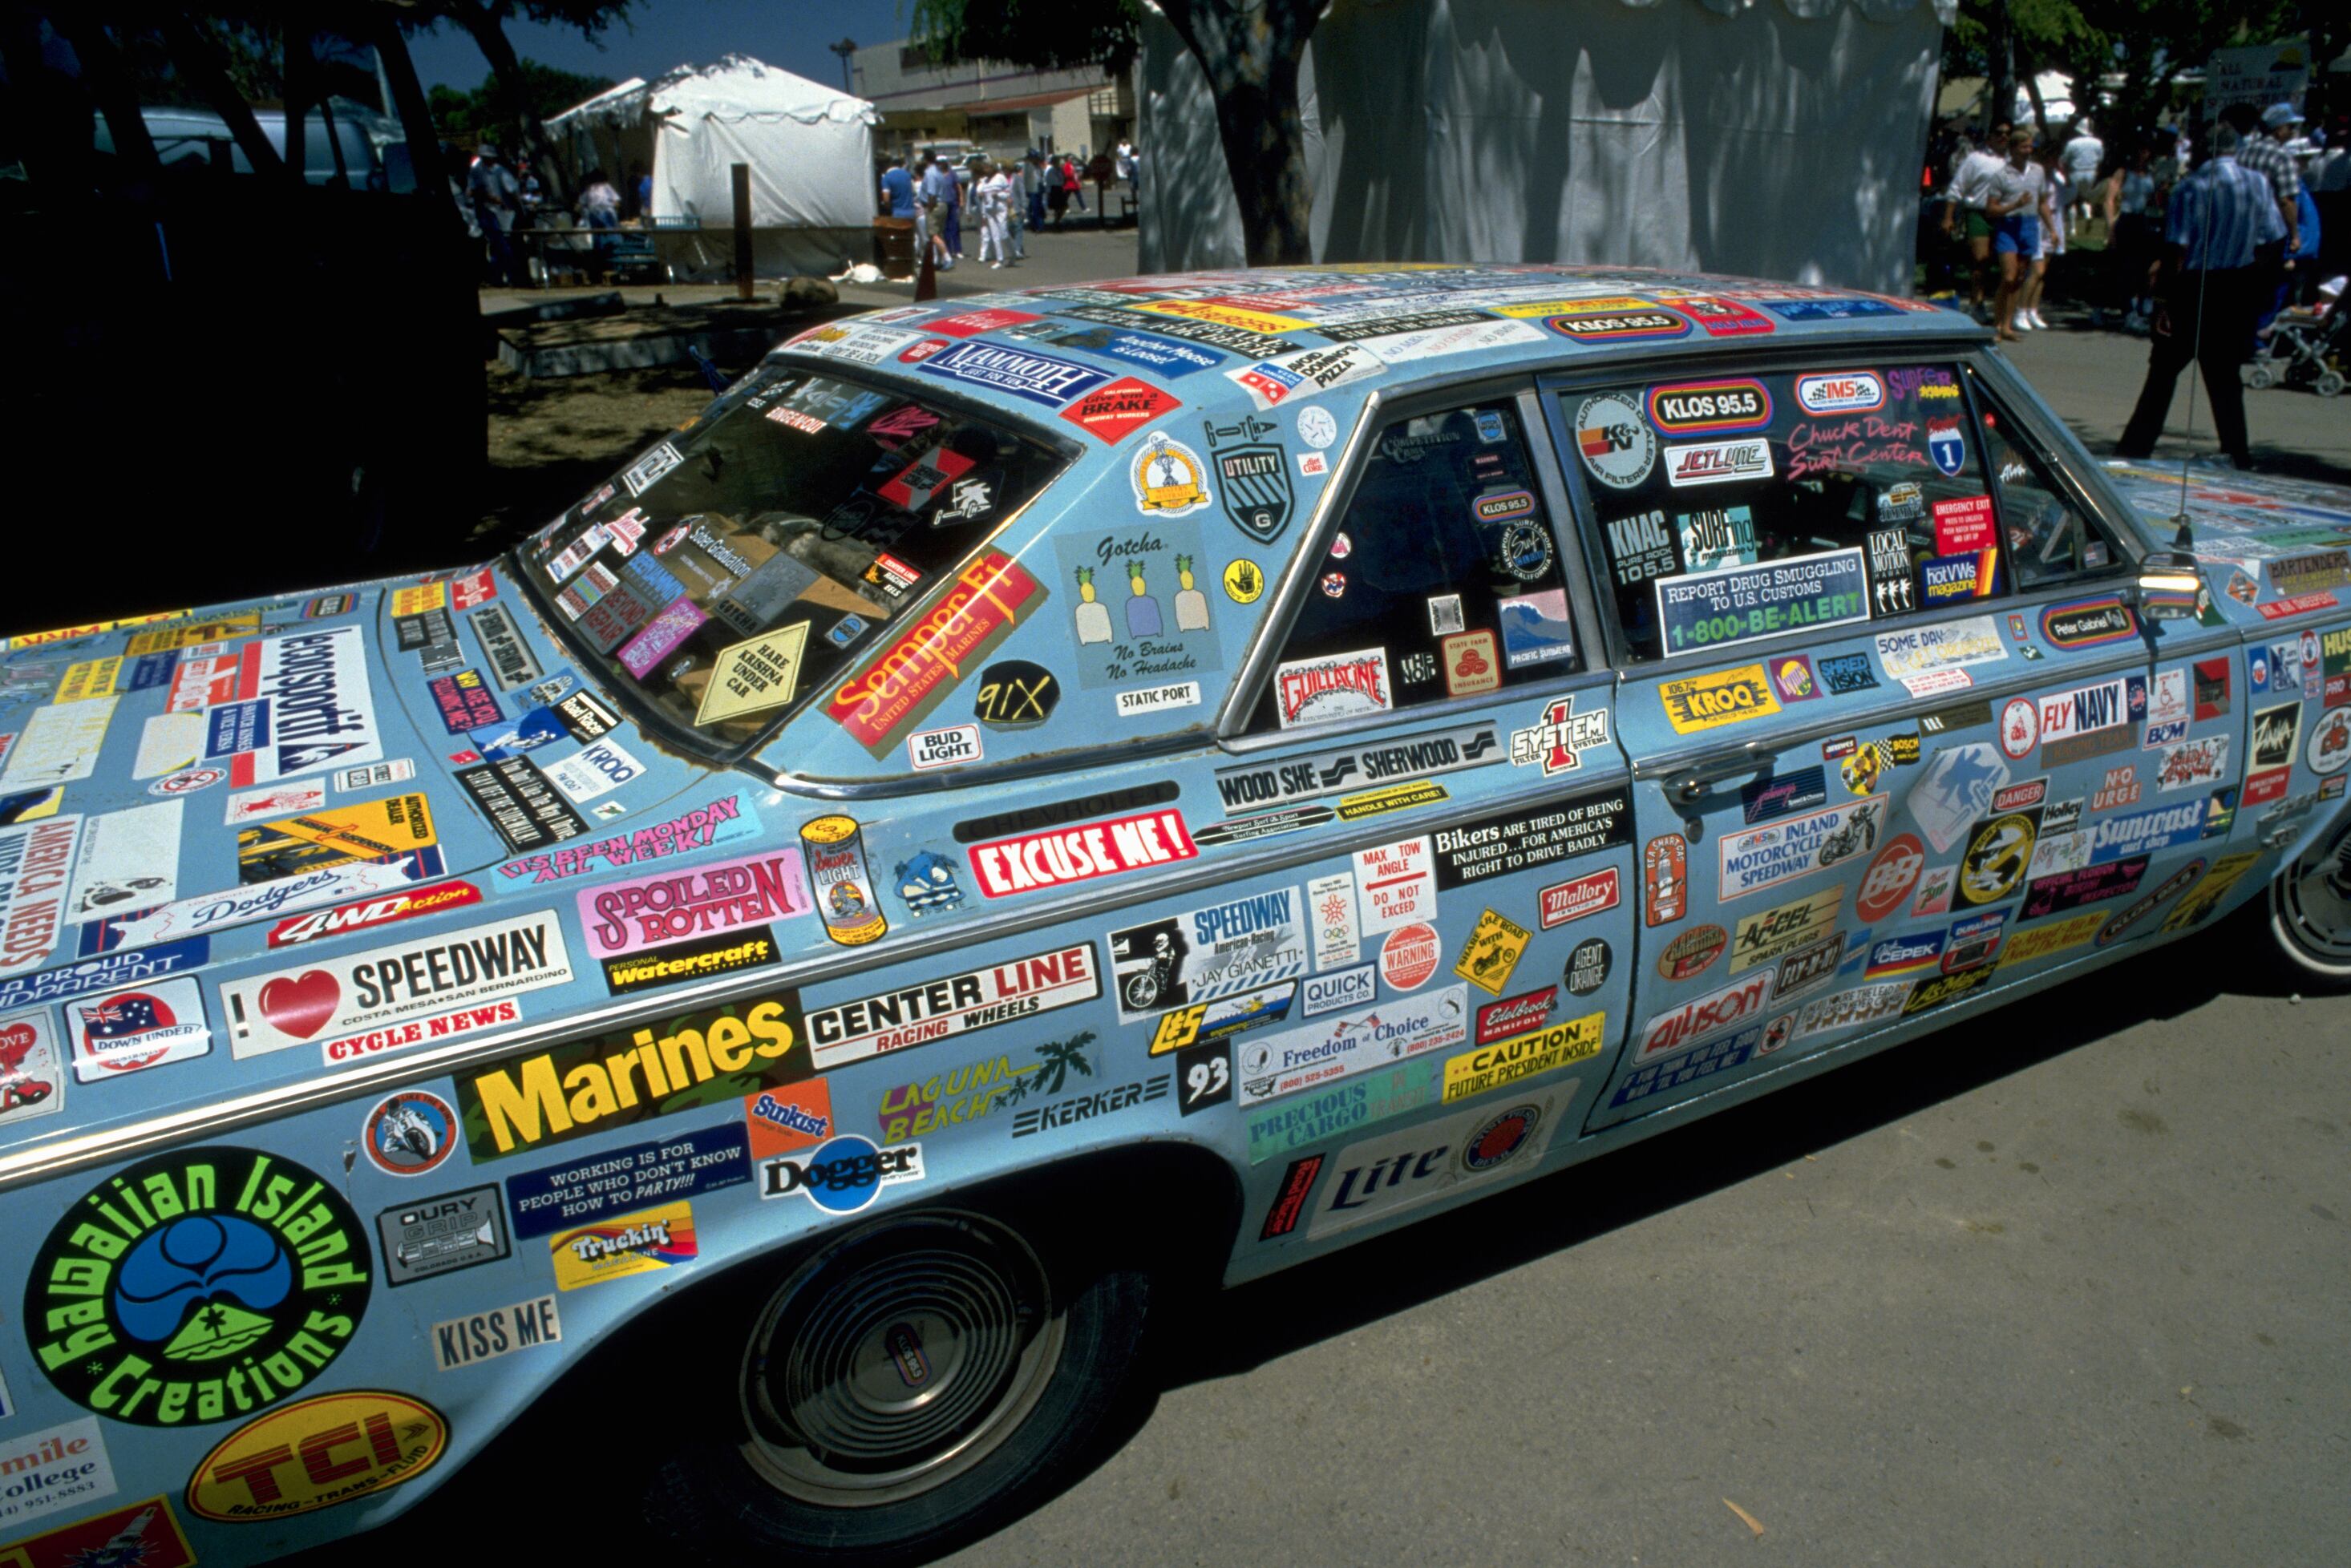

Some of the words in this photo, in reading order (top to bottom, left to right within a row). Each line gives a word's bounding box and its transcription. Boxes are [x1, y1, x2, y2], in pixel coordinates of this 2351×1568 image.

[939, 345, 1095, 396] MAMMOTH
[1287, 351, 1324, 373] AVOID
[1301, 344, 1360, 377] DOMINO'S
[1314, 360, 1355, 388] PIZZA
[964, 367, 985, 375] JUST
[987, 372, 1003, 382] FOR
[1004, 377, 1022, 386] FUN
[1826, 381, 1855, 399] IMS
[1082, 398, 1157, 416] BRAKE
[1084, 414, 1115, 423] HIGHWAY
[1663, 397, 1716, 419] KLOS
[1718, 393, 1757, 413] 95.5
[1788, 422, 1860, 452] Chuck
[1863, 416, 1919, 441] Dent
[1224, 456, 1277, 478] UTILITY
[1941, 443, 1955, 467] 1
[1483, 502, 1507, 515] KLOS
[1508, 499, 1528, 510] 95.5
[1936, 503, 1974, 515] EMERGENCY
[1976, 499, 1990, 510] EXIT
[1608, 510, 1669, 559] KNAC
[1870, 531, 1906, 556] LOCAL
[1617, 555, 1645, 568] PURE
[1646, 546, 1673, 559] ROCK
[1702, 548, 1746, 560] magazine
[1873, 551, 1910, 572] MOTION
[2269, 552, 2349, 576] BARTENDERS
[1617, 556, 1676, 584] 105.5
[1667, 581, 1725, 604] REPORT
[1730, 572, 1771, 593] DRUG
[1774, 560, 1856, 584] SMUGGLING
[1710, 597, 1730, 611] TO
[1735, 592, 1758, 607] U.S.
[1761, 581, 1822, 602] CUSTOMS
[1928, 579, 1977, 598] magazine
[1672, 592, 1861, 647] 1-800-BE-ALERT
[2054, 621, 2076, 636] Peter
[2077, 616, 2107, 631] Gabriel
[738, 649, 783, 688] KRISHNA
[758, 644, 790, 669] HARE
[455, 669, 481, 688] WHY
[726, 678, 751, 699] CAR
[731, 663, 768, 694] UNDER
[1454, 677, 1494, 689] INSURANCE
[463, 688, 490, 706] ARE
[1122, 689, 1159, 708] STATIC
[1163, 685, 1191, 701] PORT
[1687, 685, 1754, 717] KROQ
[2041, 700, 2074, 734] FLY
[2074, 684, 2120, 732] NAVY
[471, 705, 500, 725] YOU
[919, 742, 972, 762] LIGHT
[925, 732, 961, 748] BUD
[1515, 753, 1542, 766] FILTER
[1573, 737, 1608, 750] SYSTEMS
[2053, 740, 2090, 759] RACING
[2093, 729, 2130, 747] TEAM
[1217, 770, 1280, 807] WOOD
[1283, 763, 1319, 796] SHE
[1363, 738, 1459, 780] SHERWOOD
[1344, 802, 1383, 816] HANDLE
[1387, 796, 1410, 806] WITH
[1410, 790, 1441, 802] CARE!
[1996, 784, 2045, 809] DANGER
[2093, 783, 2139, 809] URGE
[1435, 826, 1499, 854] Bikers
[1503, 821, 1528, 836] ARE
[1530, 814, 1565, 831] TIRED
[1568, 809, 1584, 822] OF
[1587, 800, 1624, 817] BEING
[1785, 813, 1839, 840] INLAND
[2044, 802, 2083, 824] Holley
[2095, 800, 2202, 847] Suncoast
[15, 821, 77, 898] AMERICA
[1363, 848, 1386, 866] MAX
[1398, 842, 1421, 855] TOW
[1463, 859, 1504, 879] RIGHT
[1507, 855, 1523, 867] TO
[1527, 844, 1564, 863] DRIVE
[1568, 834, 1606, 853] BADLY
[1726, 831, 1823, 875] MOTORCYCLE
[819, 865, 860, 885] LIGHT
[1378, 859, 1409, 877] ANGLE
[1740, 854, 1811, 887] SPEEDWAY
[192, 870, 342, 925] Dodgers
[1374, 891, 1388, 906] DO
[1398, 884, 1419, 899] NOT
[1194, 890, 1292, 945] SPEEDWAY
[1382, 901, 1415, 919] EXCEED
[1, 899, 61, 967] NEEDS
[352, 924, 548, 1009] SPEEDWAY
[613, 940, 768, 985] Watercraft
[1386, 943, 1434, 969] WARNING
[1575, 944, 1603, 963] AGENT
[2, 980, 23, 993] A
[35, 953, 144, 986] PROUD
[1196, 969, 1223, 988] JAY
[1228, 949, 1297, 979] GIANETTI
[342, 1008, 391, 1026] COSTA
[480, 969, 567, 995] BERNARDINO
[812, 976, 983, 1044] CENTER
[994, 948, 1087, 998] LINE
[1308, 972, 1370, 1001] QUICK
[1308, 995, 1354, 1011] PRODUCTS
[1357, 991, 1370, 999] CO.
[98, 1037, 141, 1049] DOWN
[147, 1026, 192, 1041] UNDER
[328, 1024, 422, 1061] CYCLE
[430, 1002, 516, 1037] NEWS
[876, 1020, 948, 1053] RACING
[963, 996, 1039, 1028] WHEELS
[1283, 1036, 1357, 1068] Freedom
[1362, 1033, 1370, 1042] of
[1374, 1016, 1429, 1042] Choice
[1471, 1024, 1581, 1072] CAUTION
[475, 1001, 795, 1154] Marines
[1187, 1057, 1228, 1105] 93
[1281, 1077, 1302, 1091] (800)
[1305, 1065, 1345, 1083] 525-5355
[1447, 1070, 1495, 1101] FUTURE
[1497, 1050, 1558, 1086] PRESIDENT
[1558, 1039, 1597, 1065] INSIDE
[752, 1094, 828, 1138] Sunkist
[1250, 1082, 1366, 1144] PRECIOUS
[519, 1184, 584, 1212] PEOPLE
[594, 1175, 629, 1194] WHO
[634, 1162, 685, 1183] DON'T
[691, 1146, 742, 1169] KNOW
[550, 1157, 633, 1187] WORKING
[639, 1151, 655, 1165] IS
[662, 1143, 694, 1158] FOR
[764, 1146, 917, 1196] Dogger
[562, 1198, 604, 1217] HOW
[609, 1191, 633, 1205] TO
[636, 1174, 695, 1198] PARTY!!!
[236, 1156, 367, 1290] Island
[400, 1197, 478, 1226] OURY
[404, 1212, 478, 1240] GRIP
[37, 1163, 216, 1374] Hawaiian
[439, 1313, 508, 1368] KISS
[514, 1299, 557, 1348] ME
[89, 1309, 354, 1423] Creations
[212, 1411, 402, 1505] TCI
[25, 1481, 95, 1507] 951-8883
